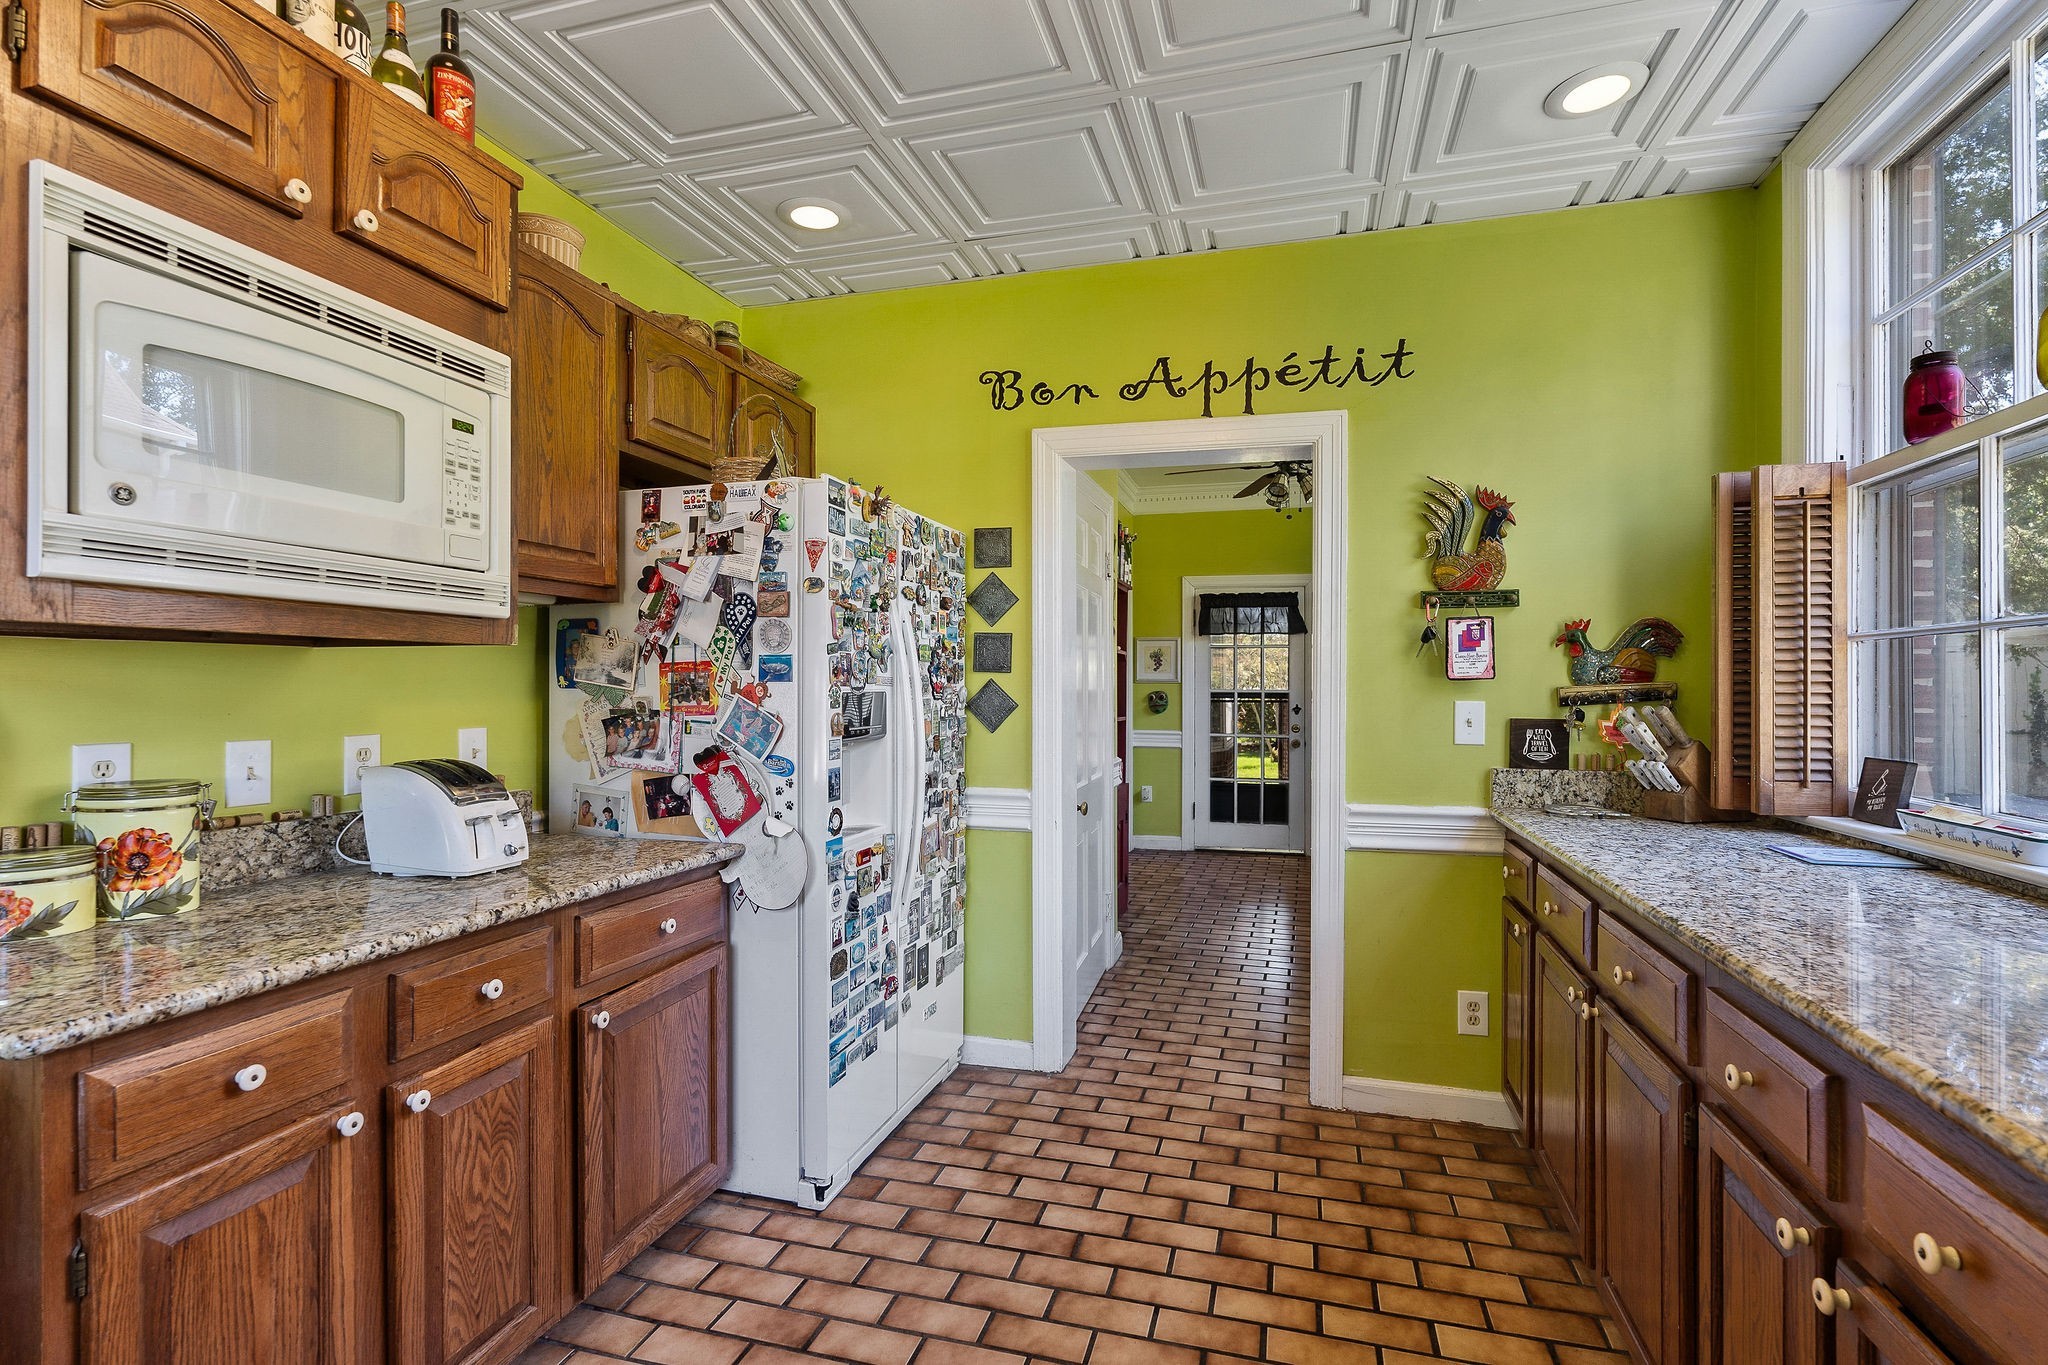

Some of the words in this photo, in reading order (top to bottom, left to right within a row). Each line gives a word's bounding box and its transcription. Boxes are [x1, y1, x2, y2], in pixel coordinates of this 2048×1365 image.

[978, 369, 1100, 411] Bon
[1119, 338, 1416, 418] Appétit
[724, 644, 734, 660] Pet
[720, 662, 730, 675] My
[1985, 839, 2008, 853] Olives
